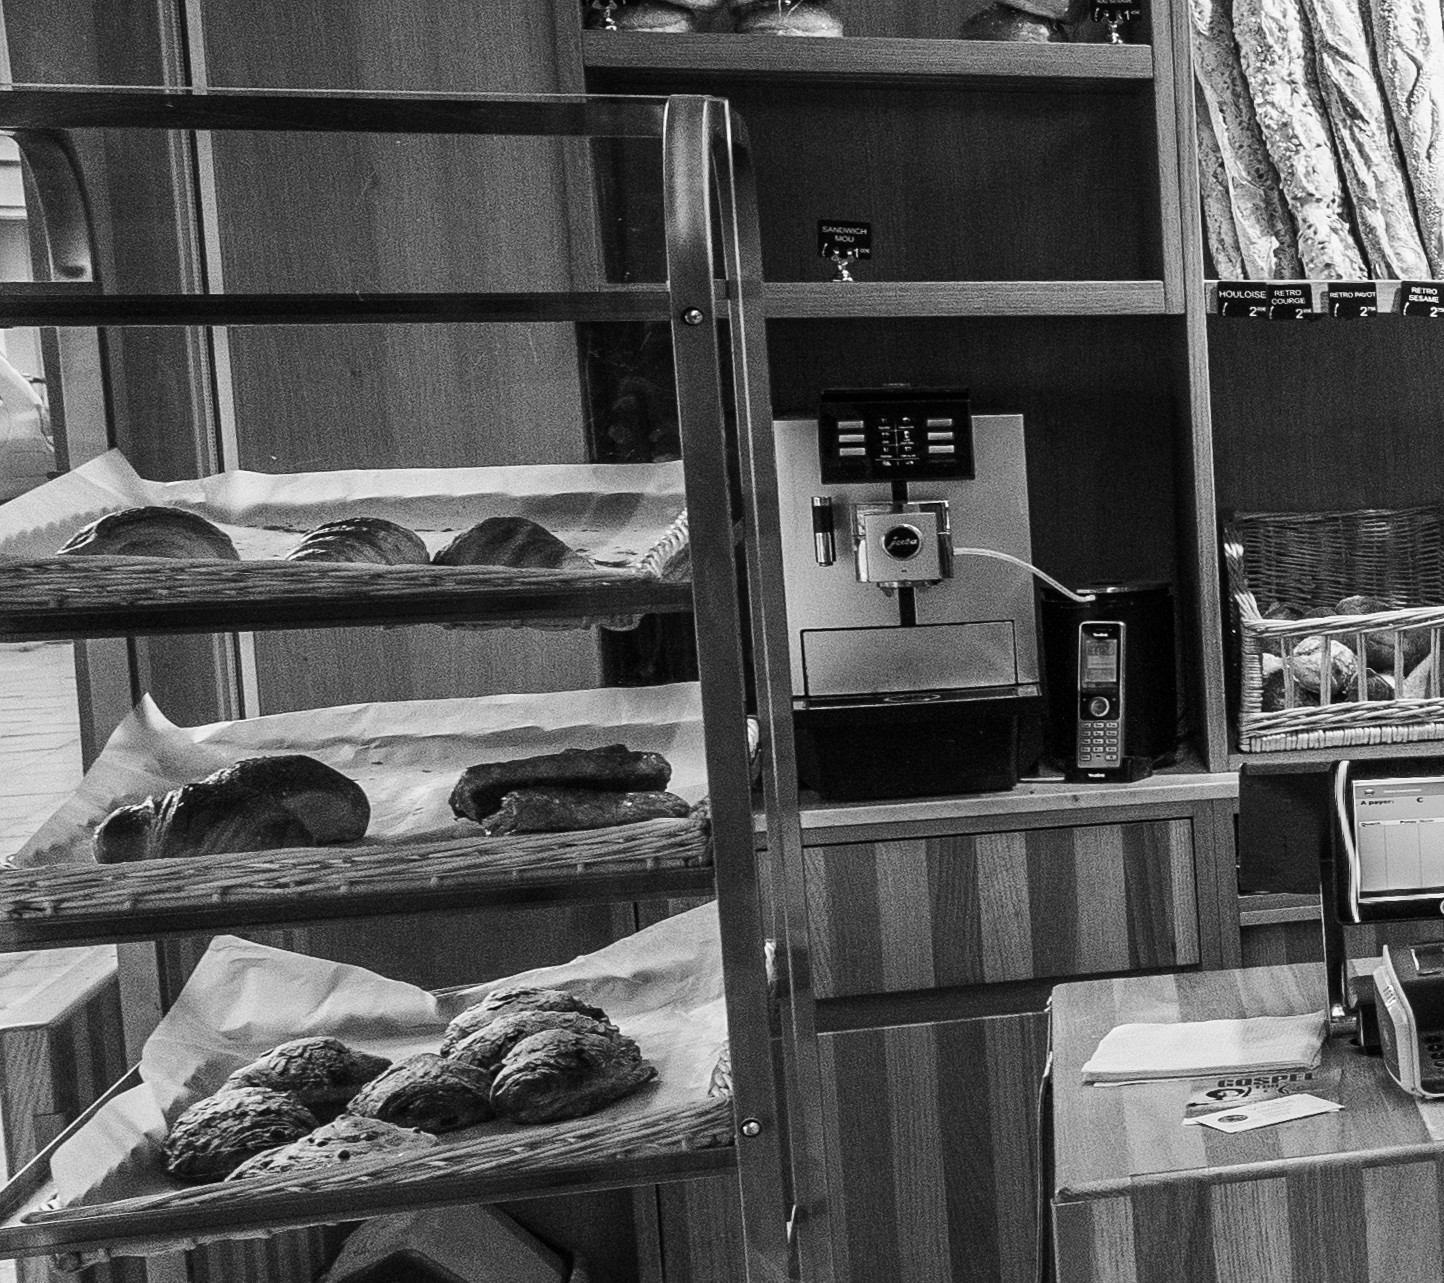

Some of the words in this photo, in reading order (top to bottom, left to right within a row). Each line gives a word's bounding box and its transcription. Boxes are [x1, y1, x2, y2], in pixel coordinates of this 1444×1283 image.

[1218, 290, 1267, 299] HOULOISE
[1273, 289, 1302, 297] RETRO
[1411, 287, 1438, 296] RETRO
[1271, 297, 1306, 305] COURGE
